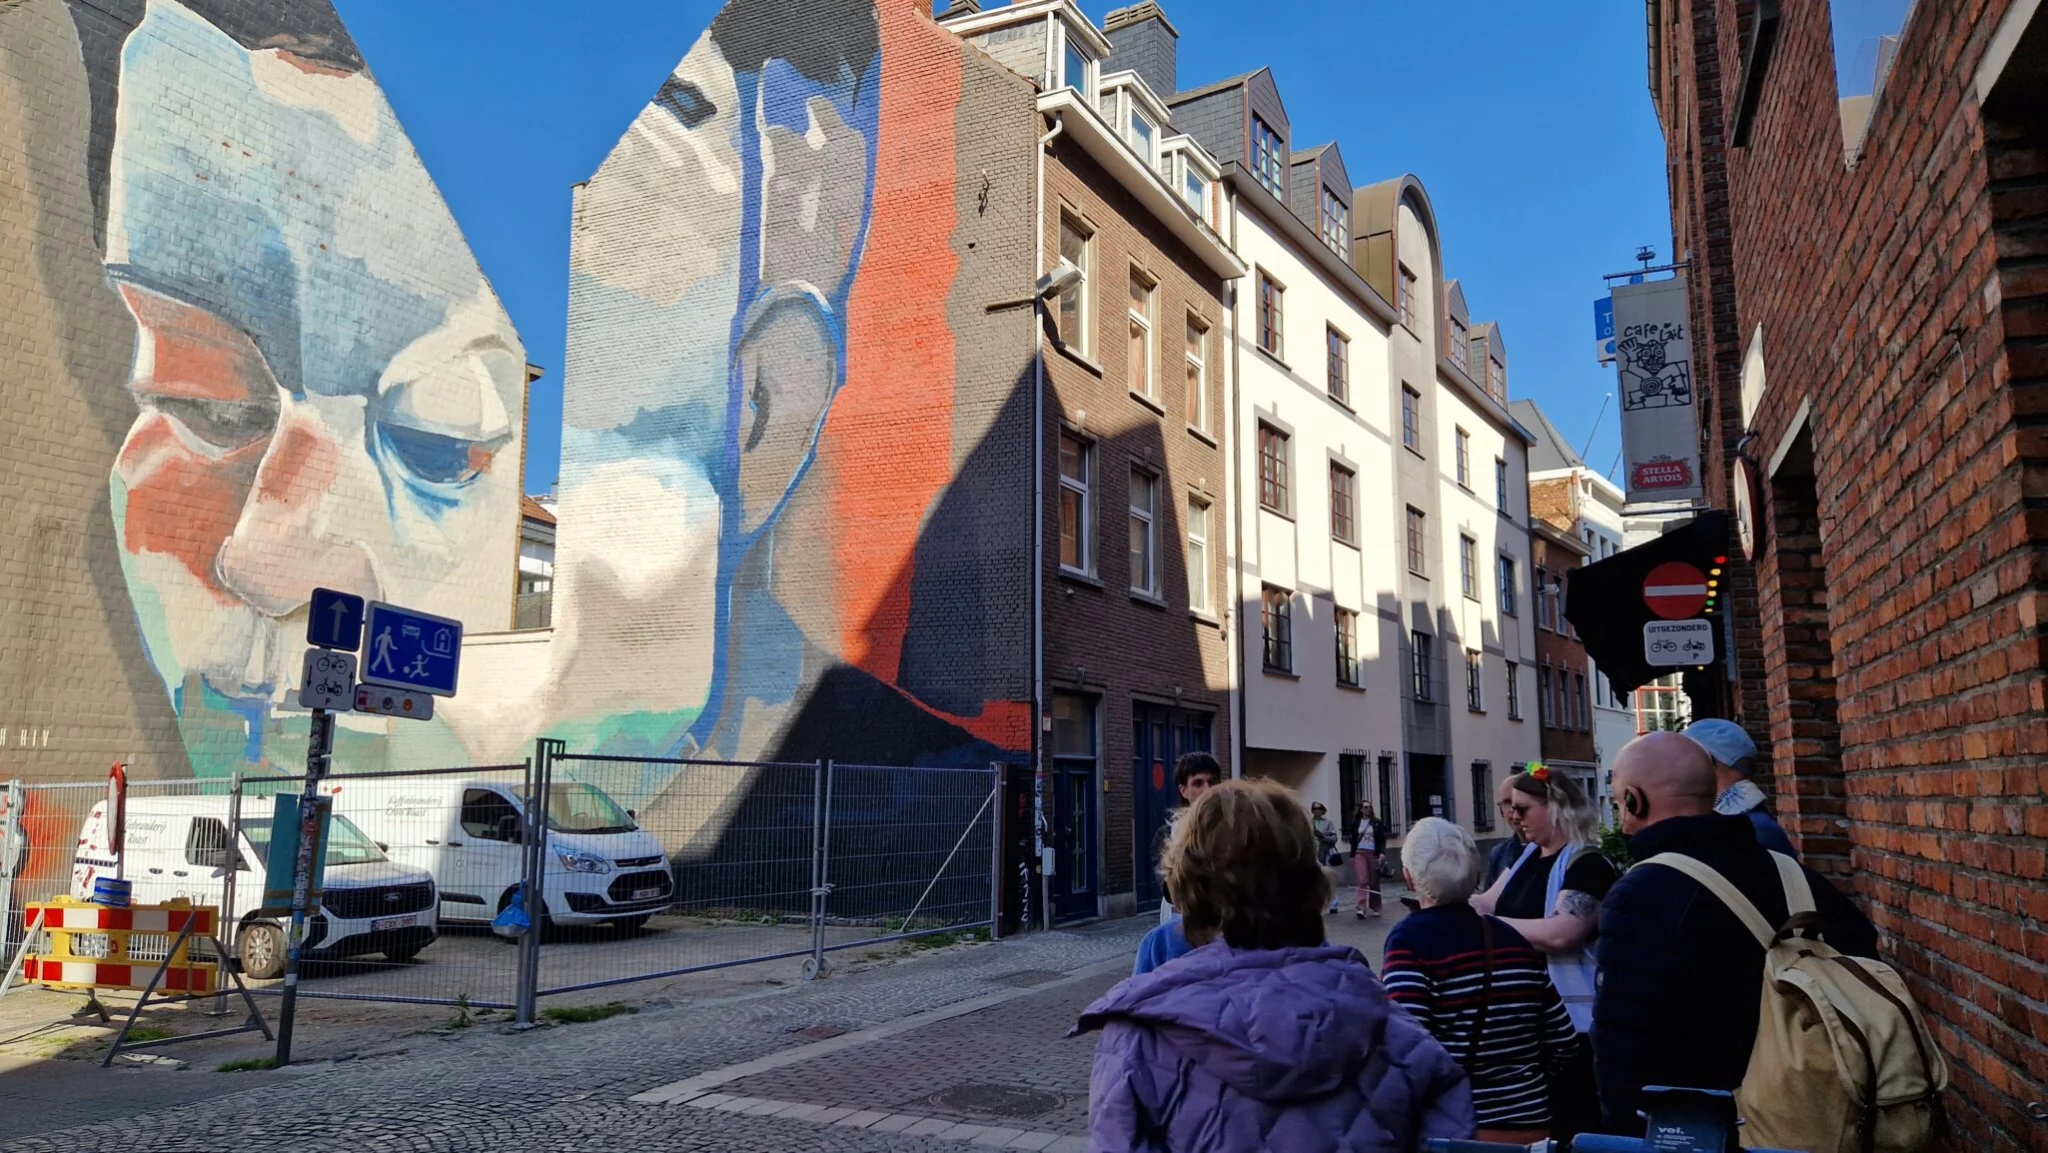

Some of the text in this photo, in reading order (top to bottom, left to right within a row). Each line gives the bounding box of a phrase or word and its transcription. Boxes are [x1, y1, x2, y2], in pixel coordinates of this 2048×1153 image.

[1642, 466, 1681, 476] STELLA
[1643, 474, 1683, 484] ARTOIS
[1648, 624, 1708, 634] UITGEZONDERD
[1693, 652, 1699, 660] P
[325, 697, 332, 707] P
[20, 729, 49, 747] HIV
